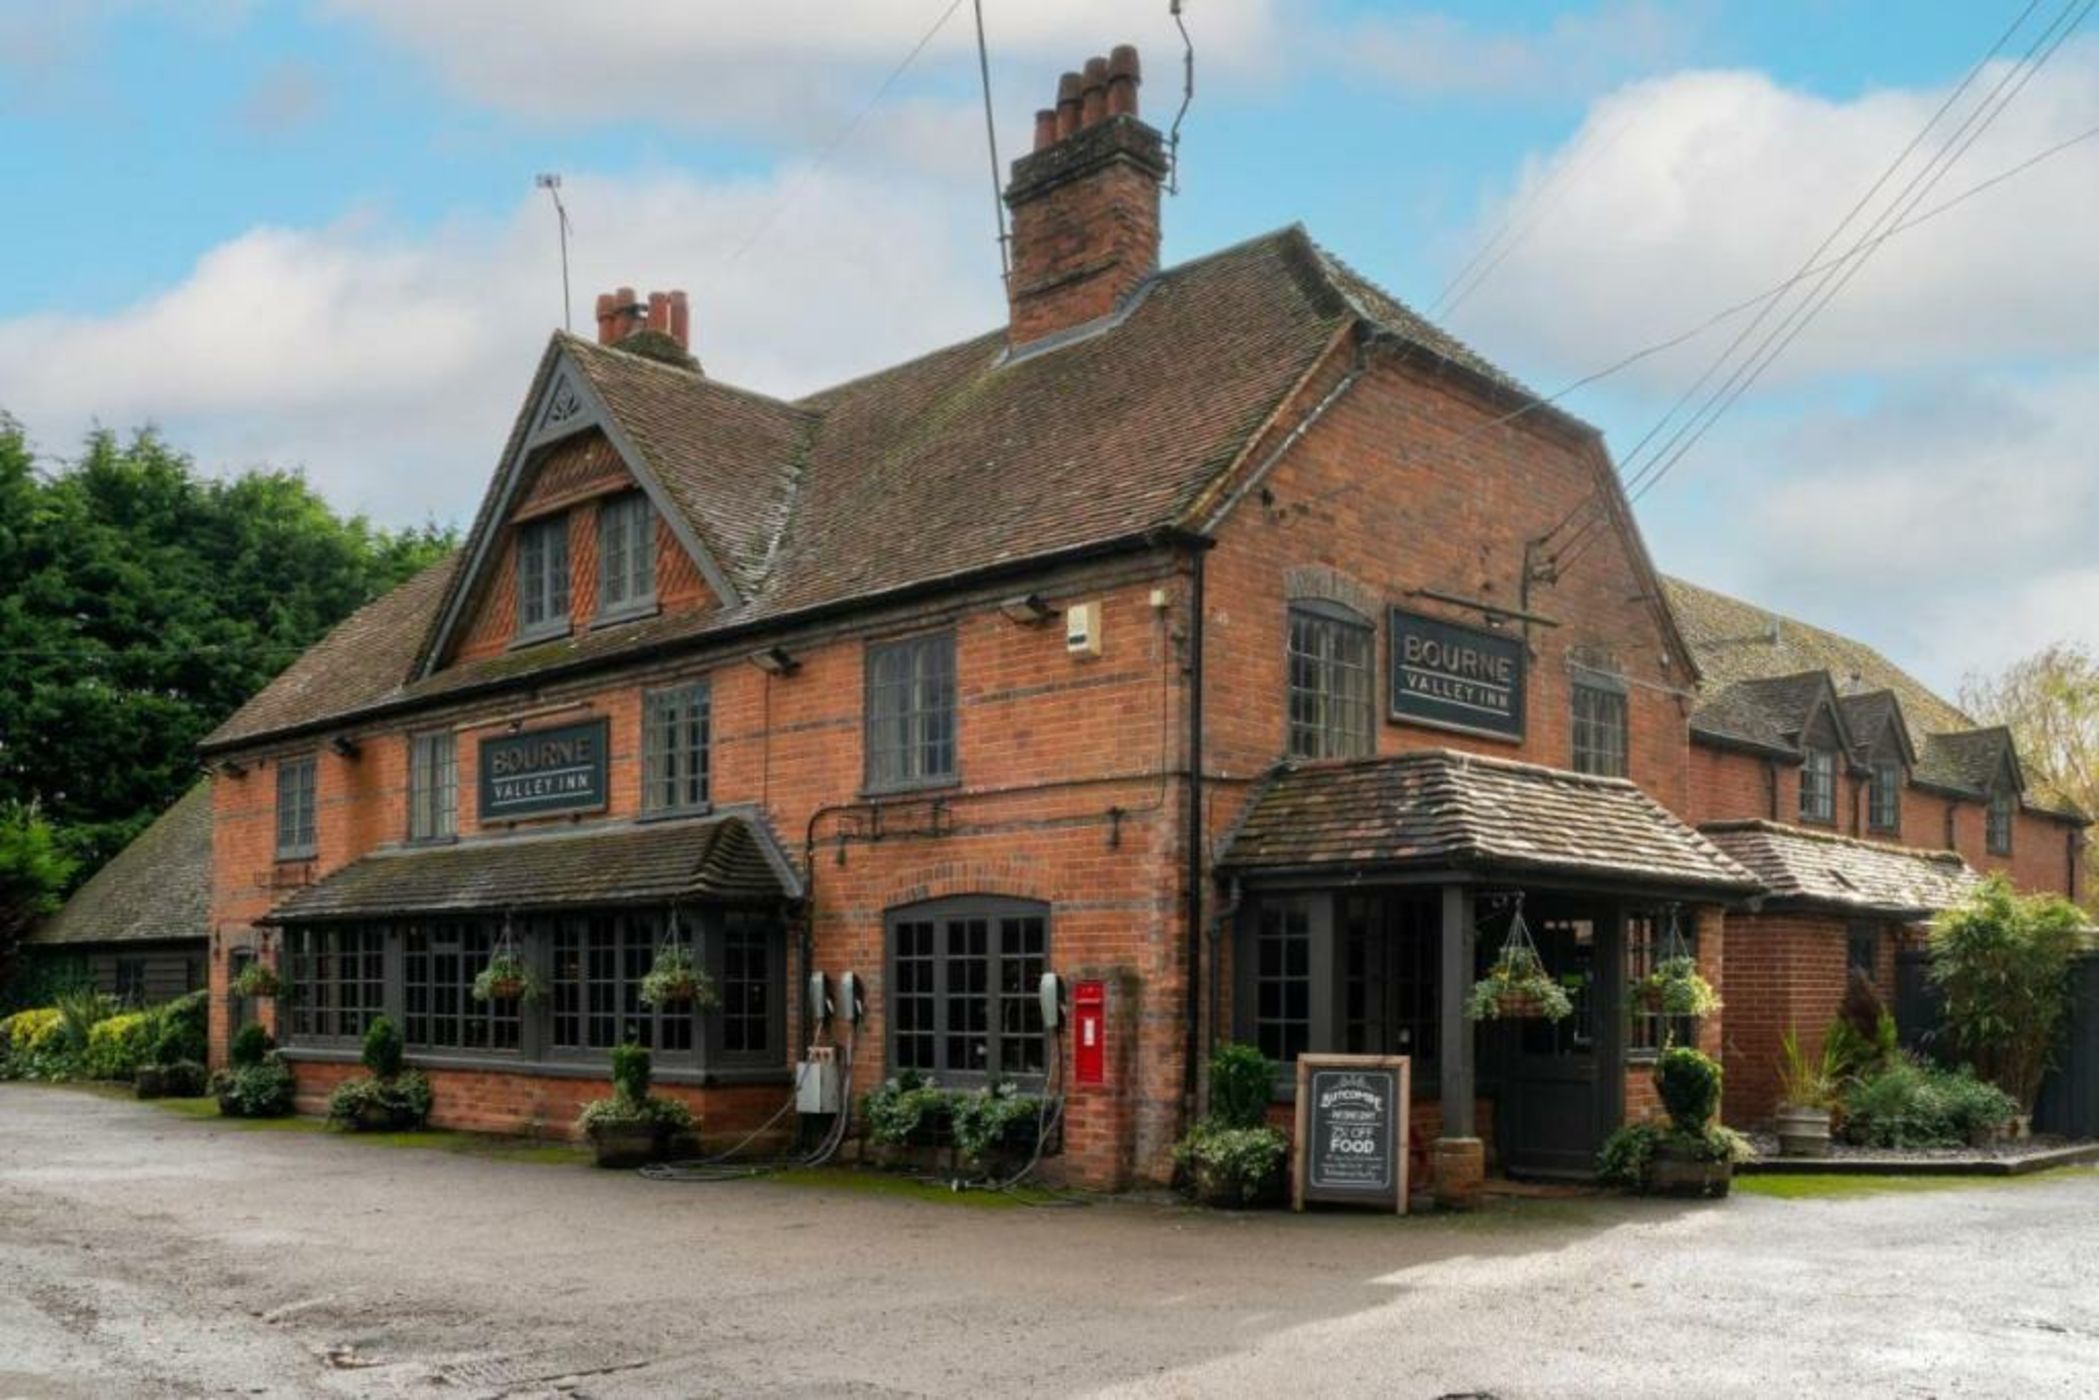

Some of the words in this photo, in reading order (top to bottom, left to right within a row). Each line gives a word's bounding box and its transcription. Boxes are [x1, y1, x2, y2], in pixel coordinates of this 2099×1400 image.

[1404, 634, 1513, 683] BOURNE
[1407, 673, 1474, 701] VALLEY
[1480, 689, 1508, 707] INN
[492, 735, 592, 775] BOURNE
[494, 778, 553, 800] VALLEY
[559, 772, 588, 791] INN
[1330, 1139, 1375, 1154] FOOD
